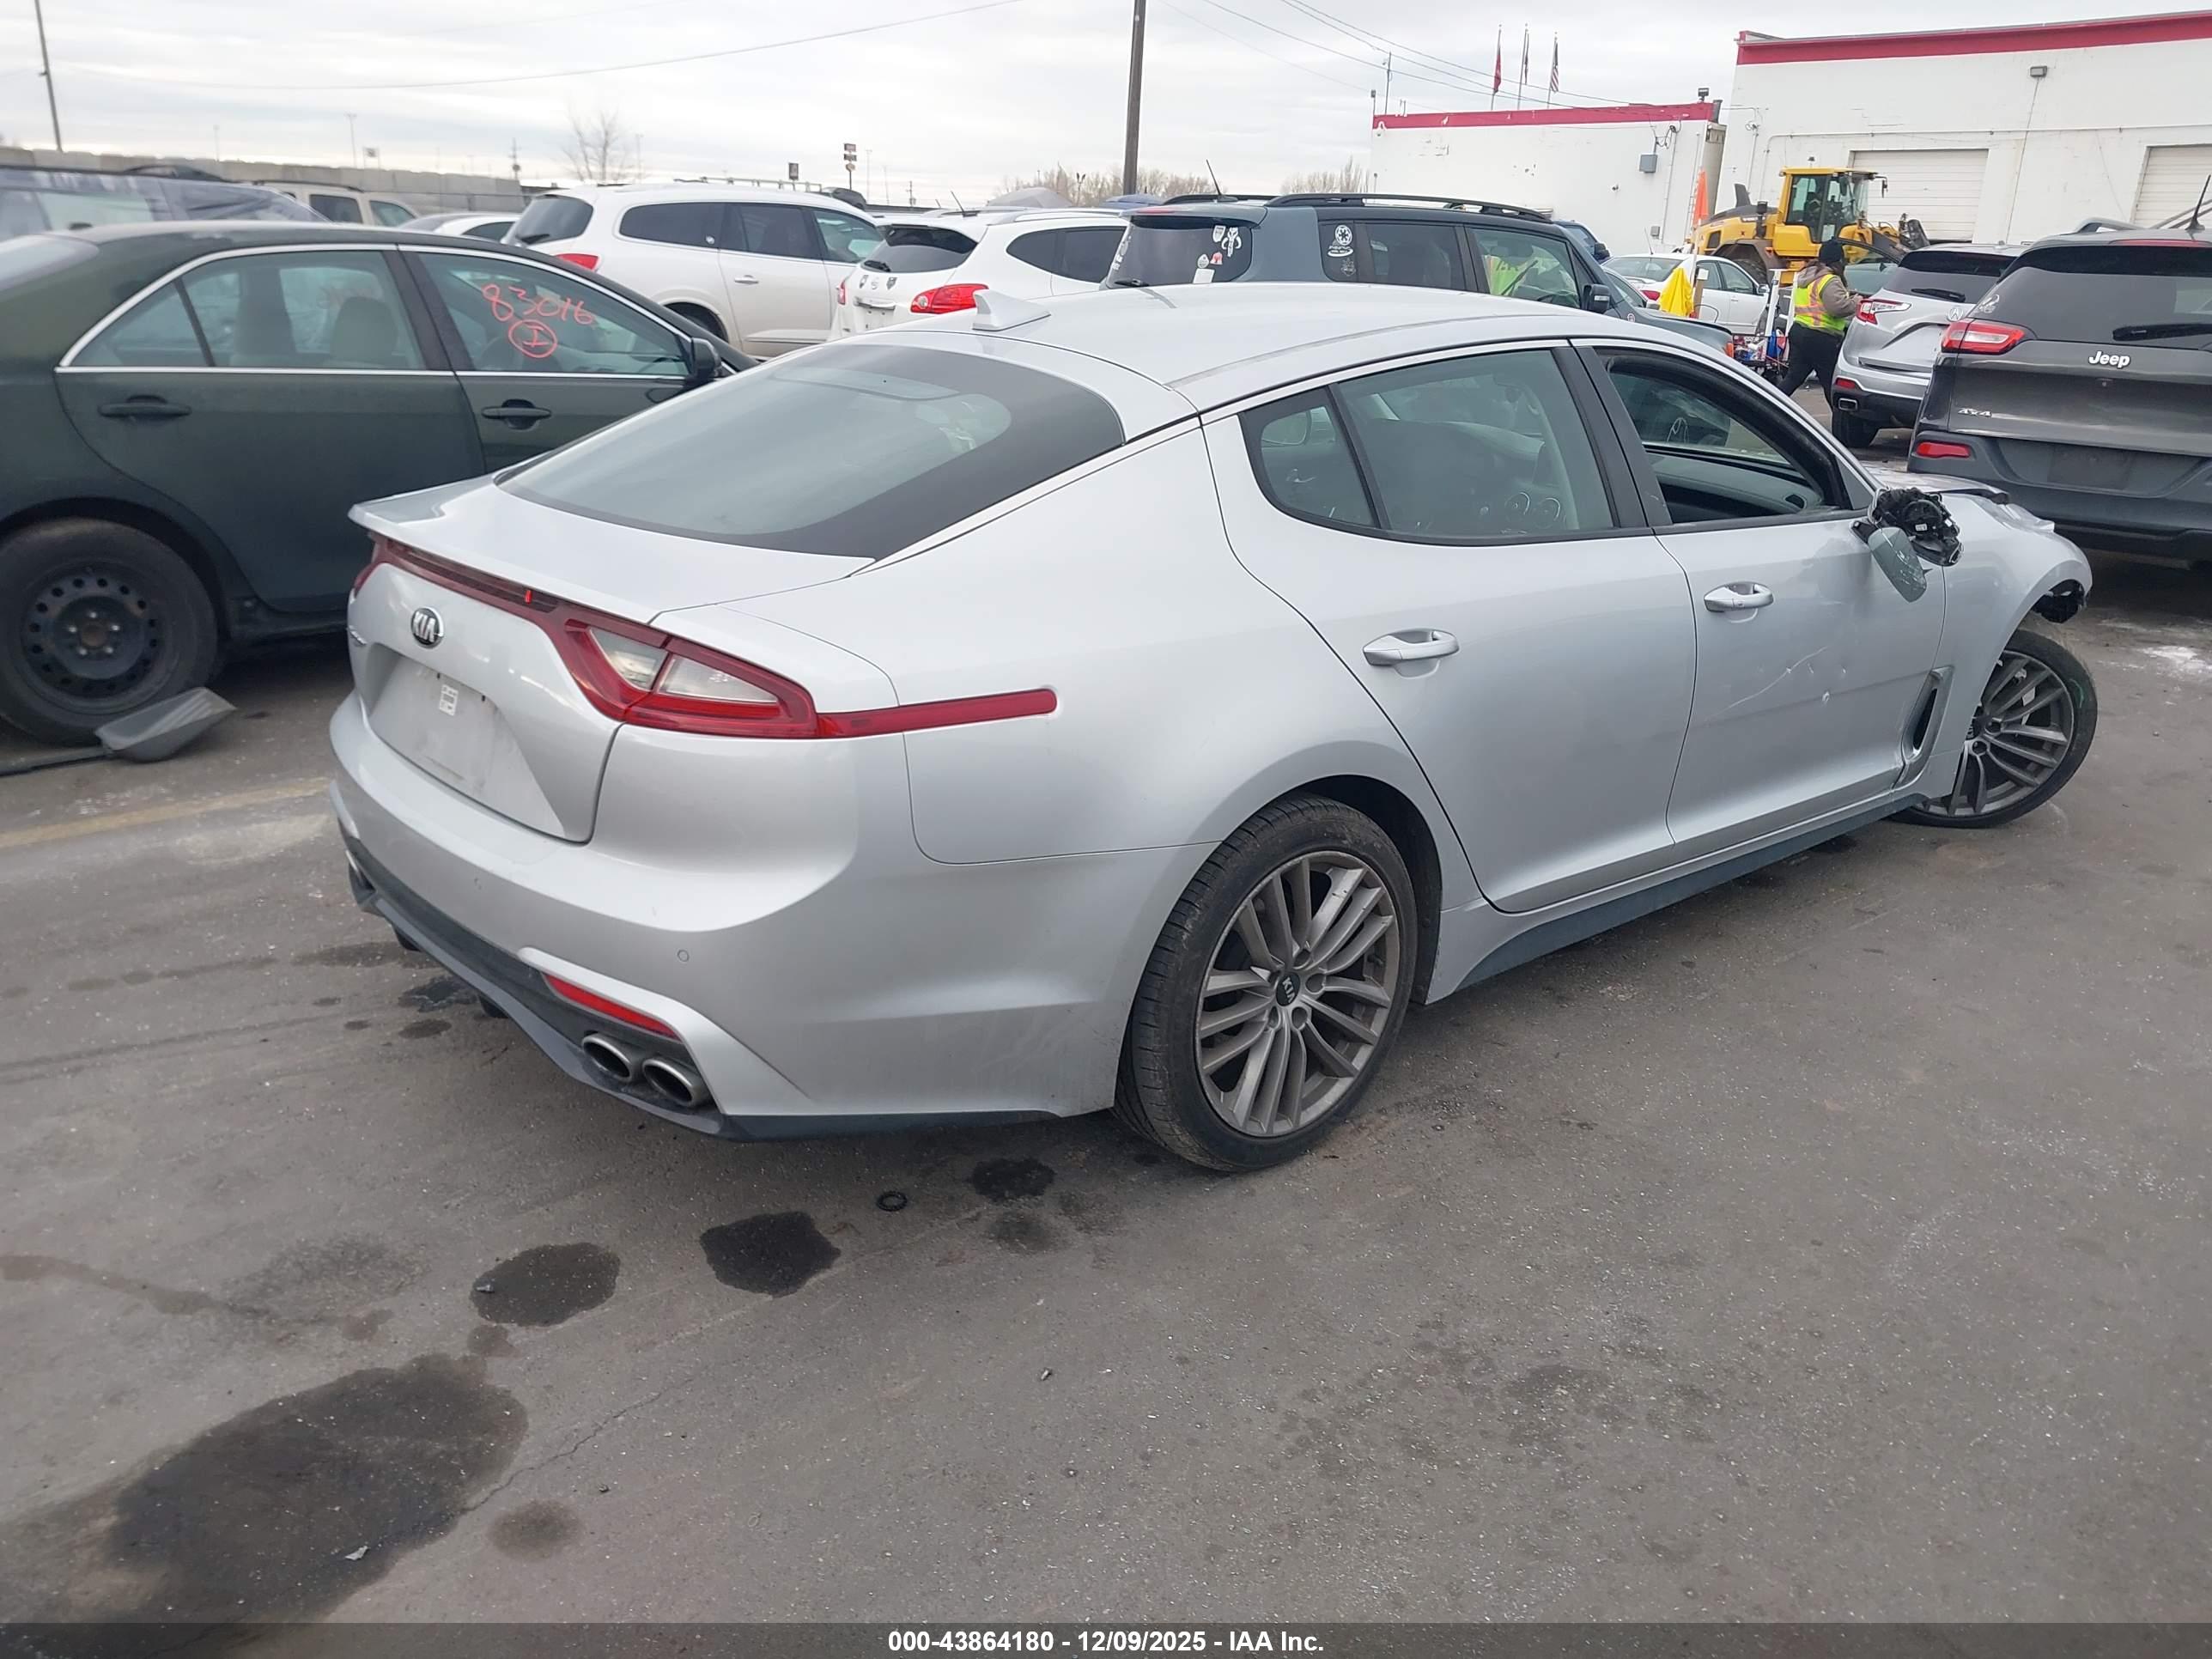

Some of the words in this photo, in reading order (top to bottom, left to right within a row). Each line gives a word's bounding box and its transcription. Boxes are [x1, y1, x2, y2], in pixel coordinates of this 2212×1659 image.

[481, 284, 597, 325] 83016
[2088, 350, 2130, 368] Jeep
[413, 611, 436, 642] KIA
[1281, 977, 1296, 1004] KIA
